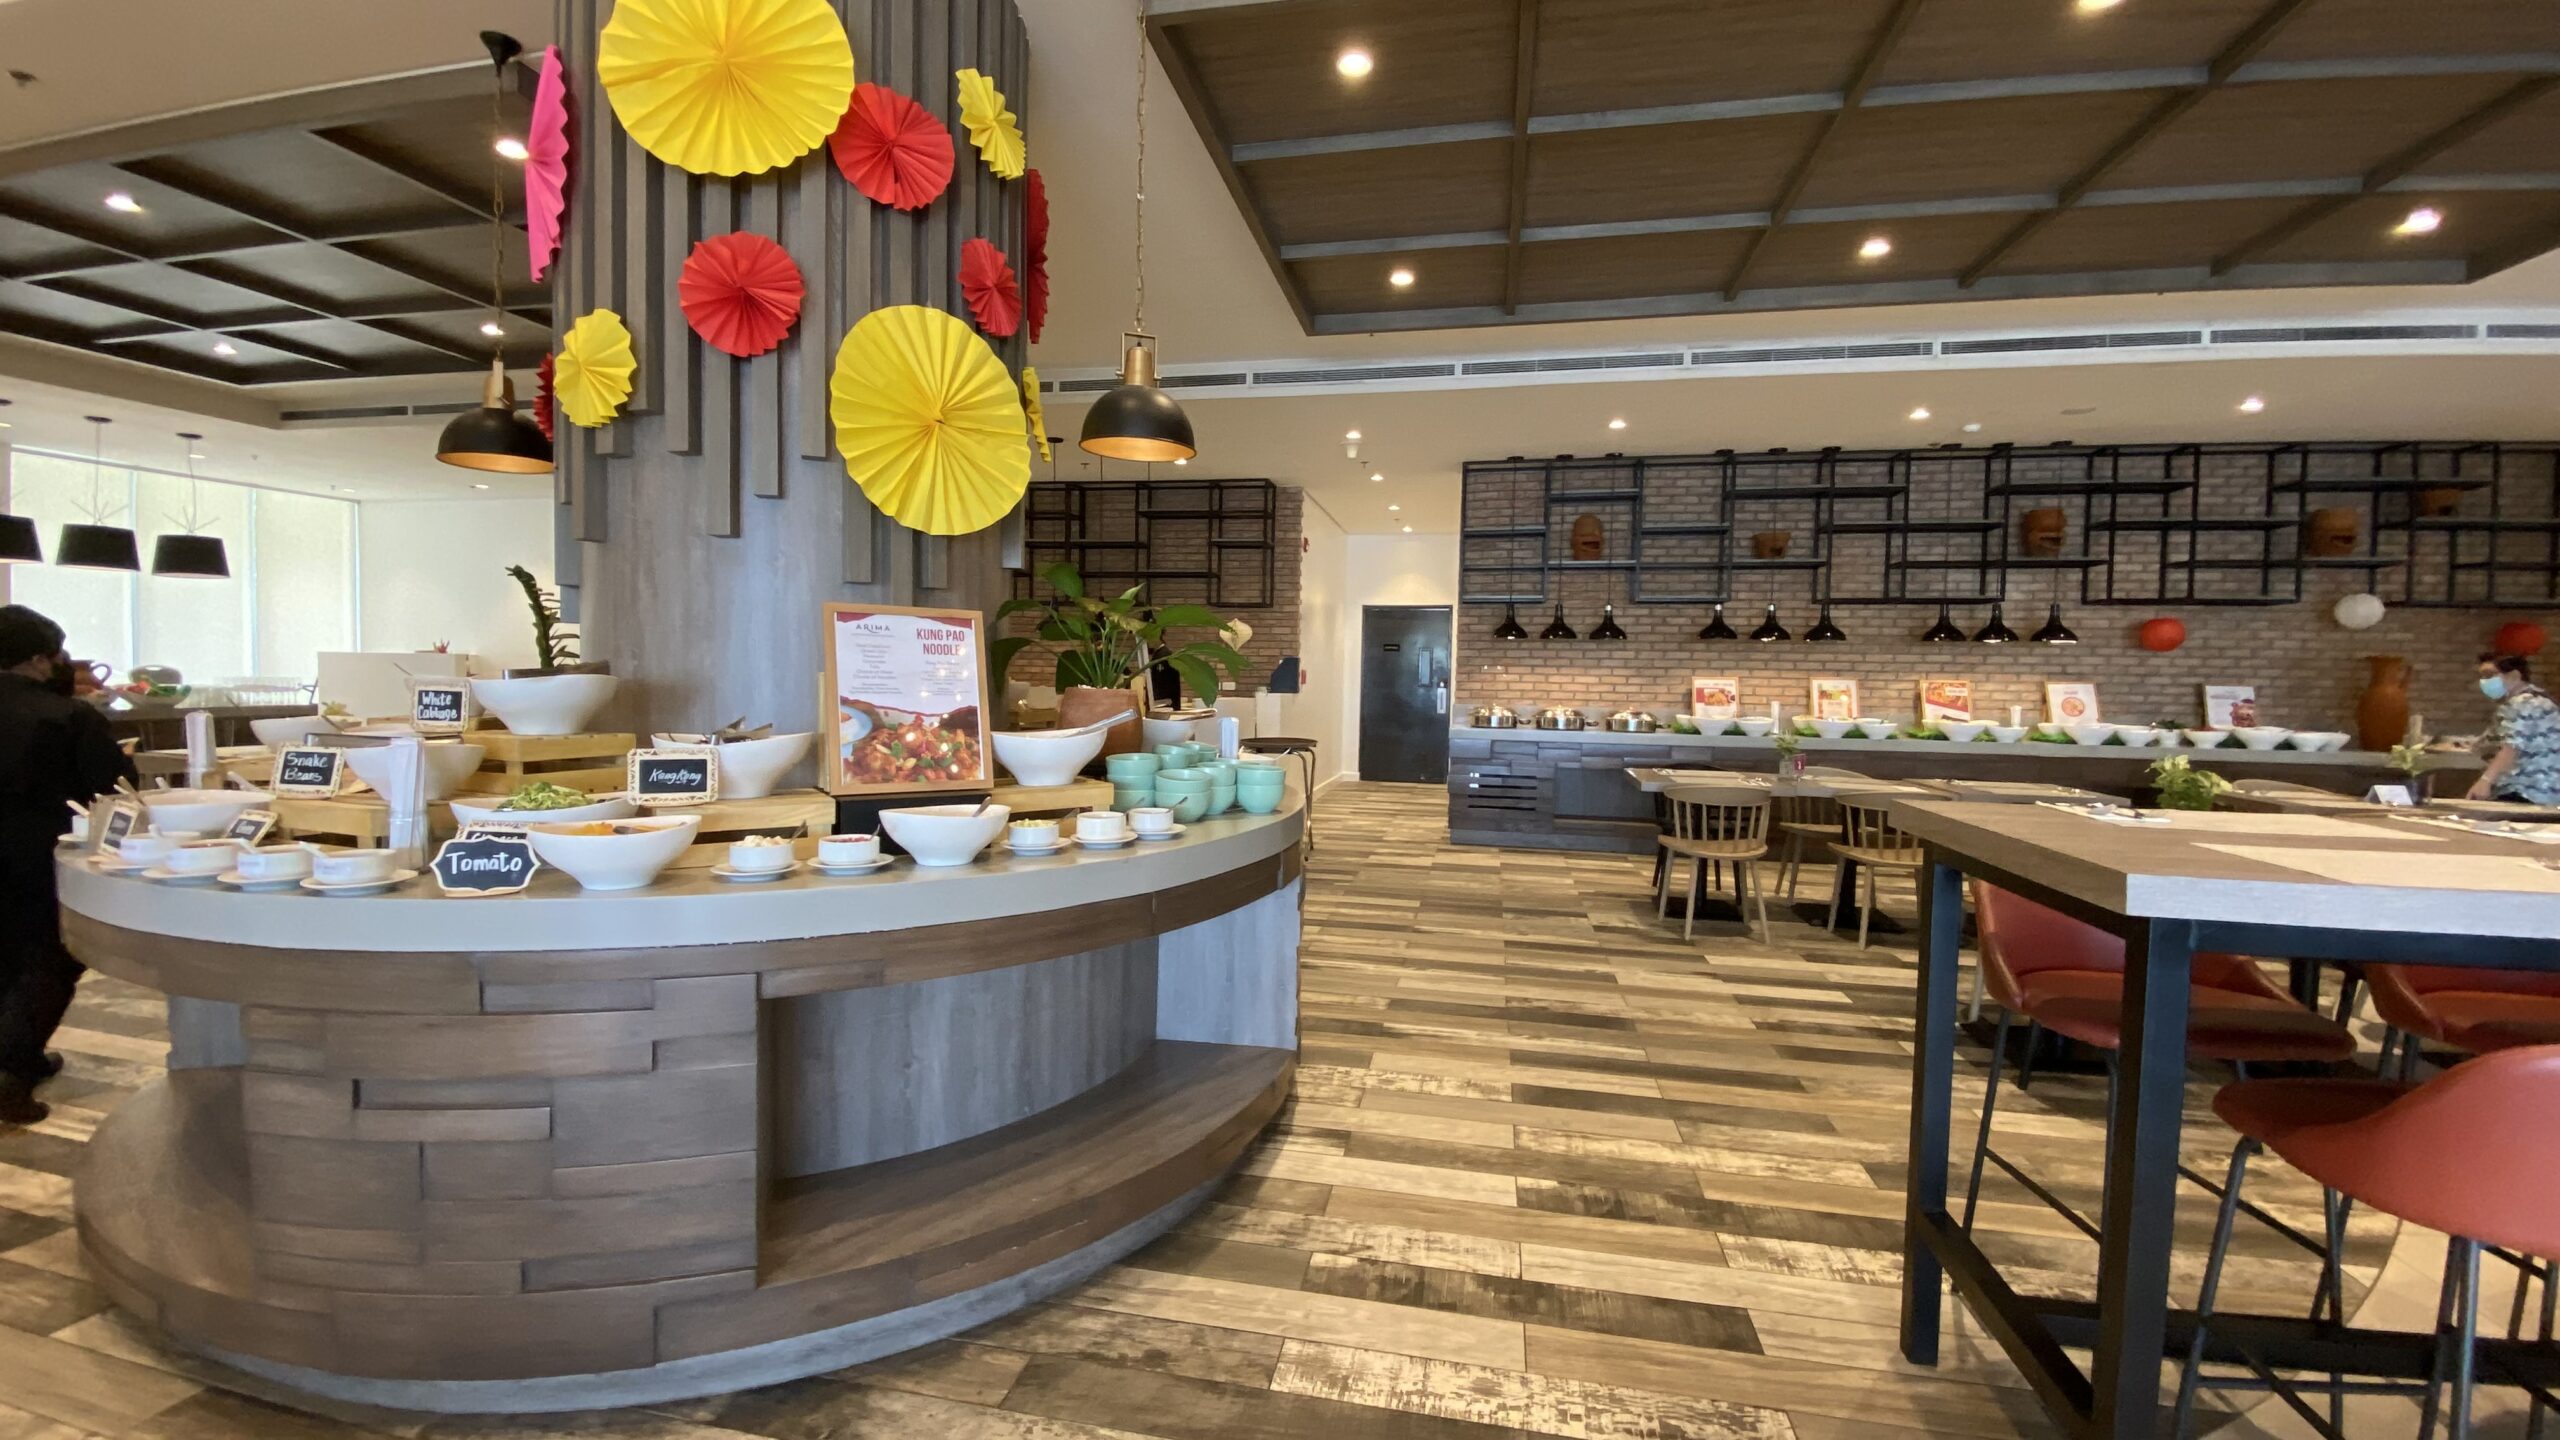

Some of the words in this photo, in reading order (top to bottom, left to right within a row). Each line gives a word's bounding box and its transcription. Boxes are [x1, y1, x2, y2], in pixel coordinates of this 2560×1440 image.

[855, 623, 891, 633] ARIMA
[916, 628, 944, 641] KUNG
[946, 629, 965, 642] PAO
[422, 691, 452, 706] White
[286, 752, 329, 768] Snake
[444, 851, 522, 875] Tomato
